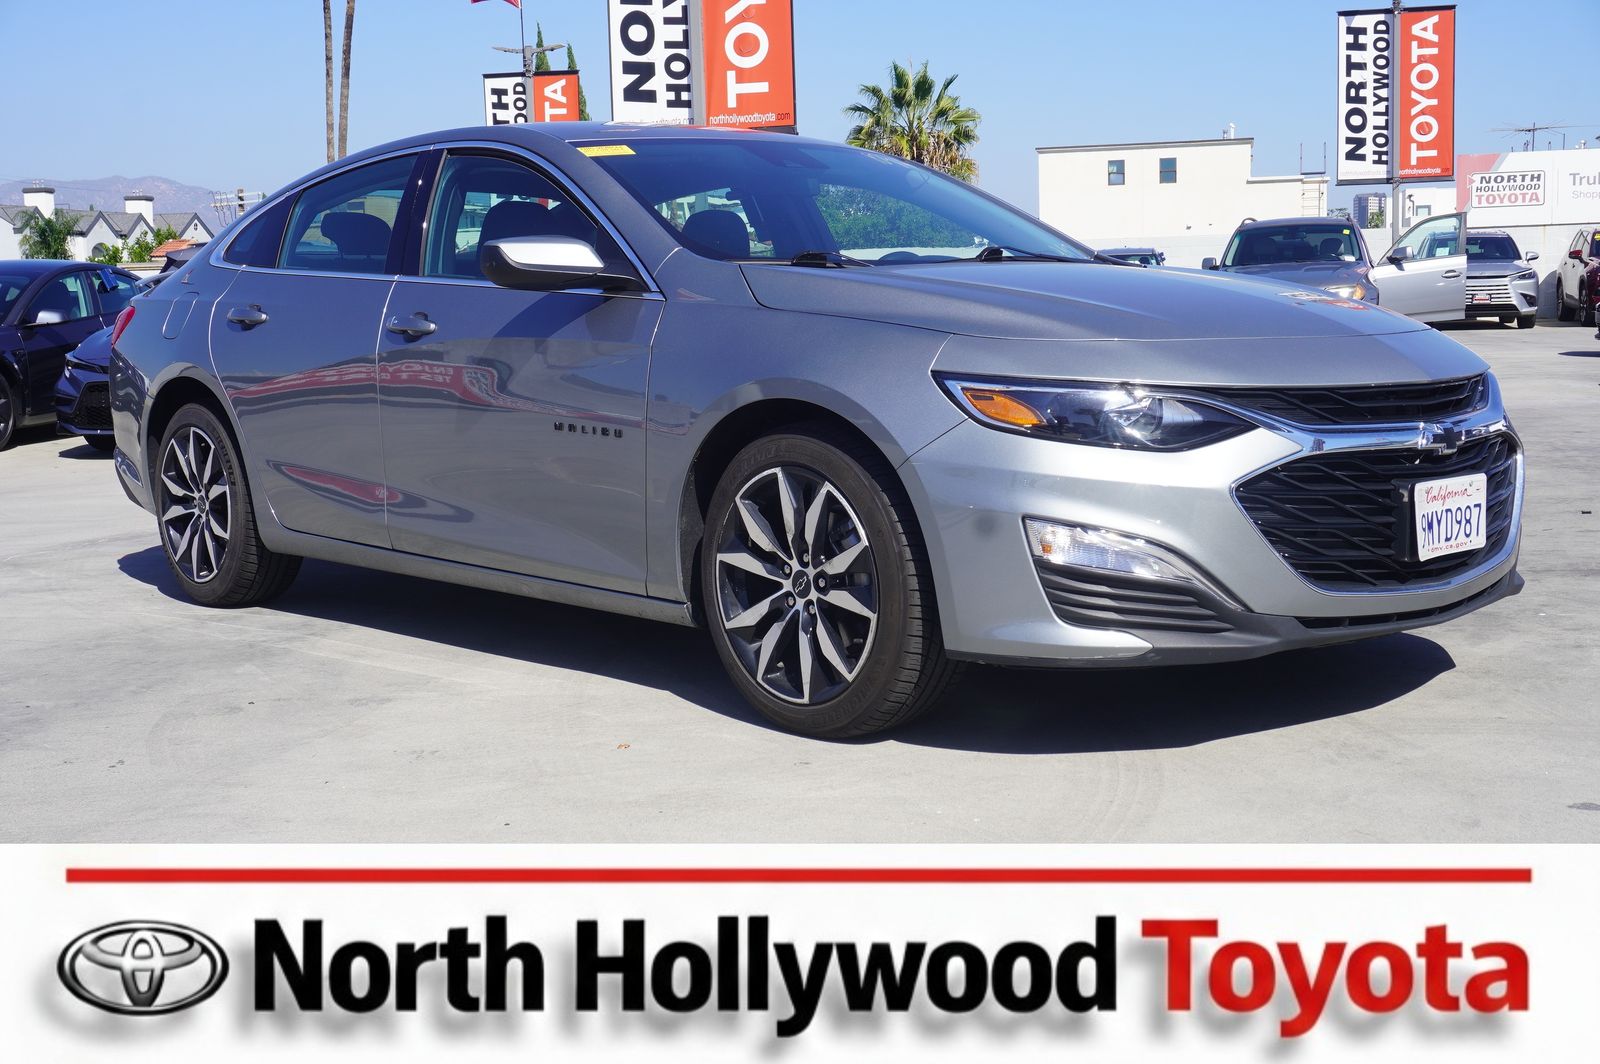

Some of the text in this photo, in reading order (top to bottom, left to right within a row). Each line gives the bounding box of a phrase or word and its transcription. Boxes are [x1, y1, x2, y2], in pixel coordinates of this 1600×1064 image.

[619, 0, 657, 104] NO
[1344, 26, 1368, 162] NORTH
[1371, 19, 1391, 165] HOLLYWOOD
[1409, 14, 1440, 165] TOYOTA
[709, 113, 791, 126] northhollywoodtoyota.com
[1475, 183, 1541, 193] HOLLYWOOD
[1479, 173, 1542, 185] NORTH
[1475, 192, 1540, 205] TOYOTA
[554, 421, 623, 438] MALIBU
[1426, 485, 1473, 507] California
[1421, 503, 1482, 549] 9MYD987
